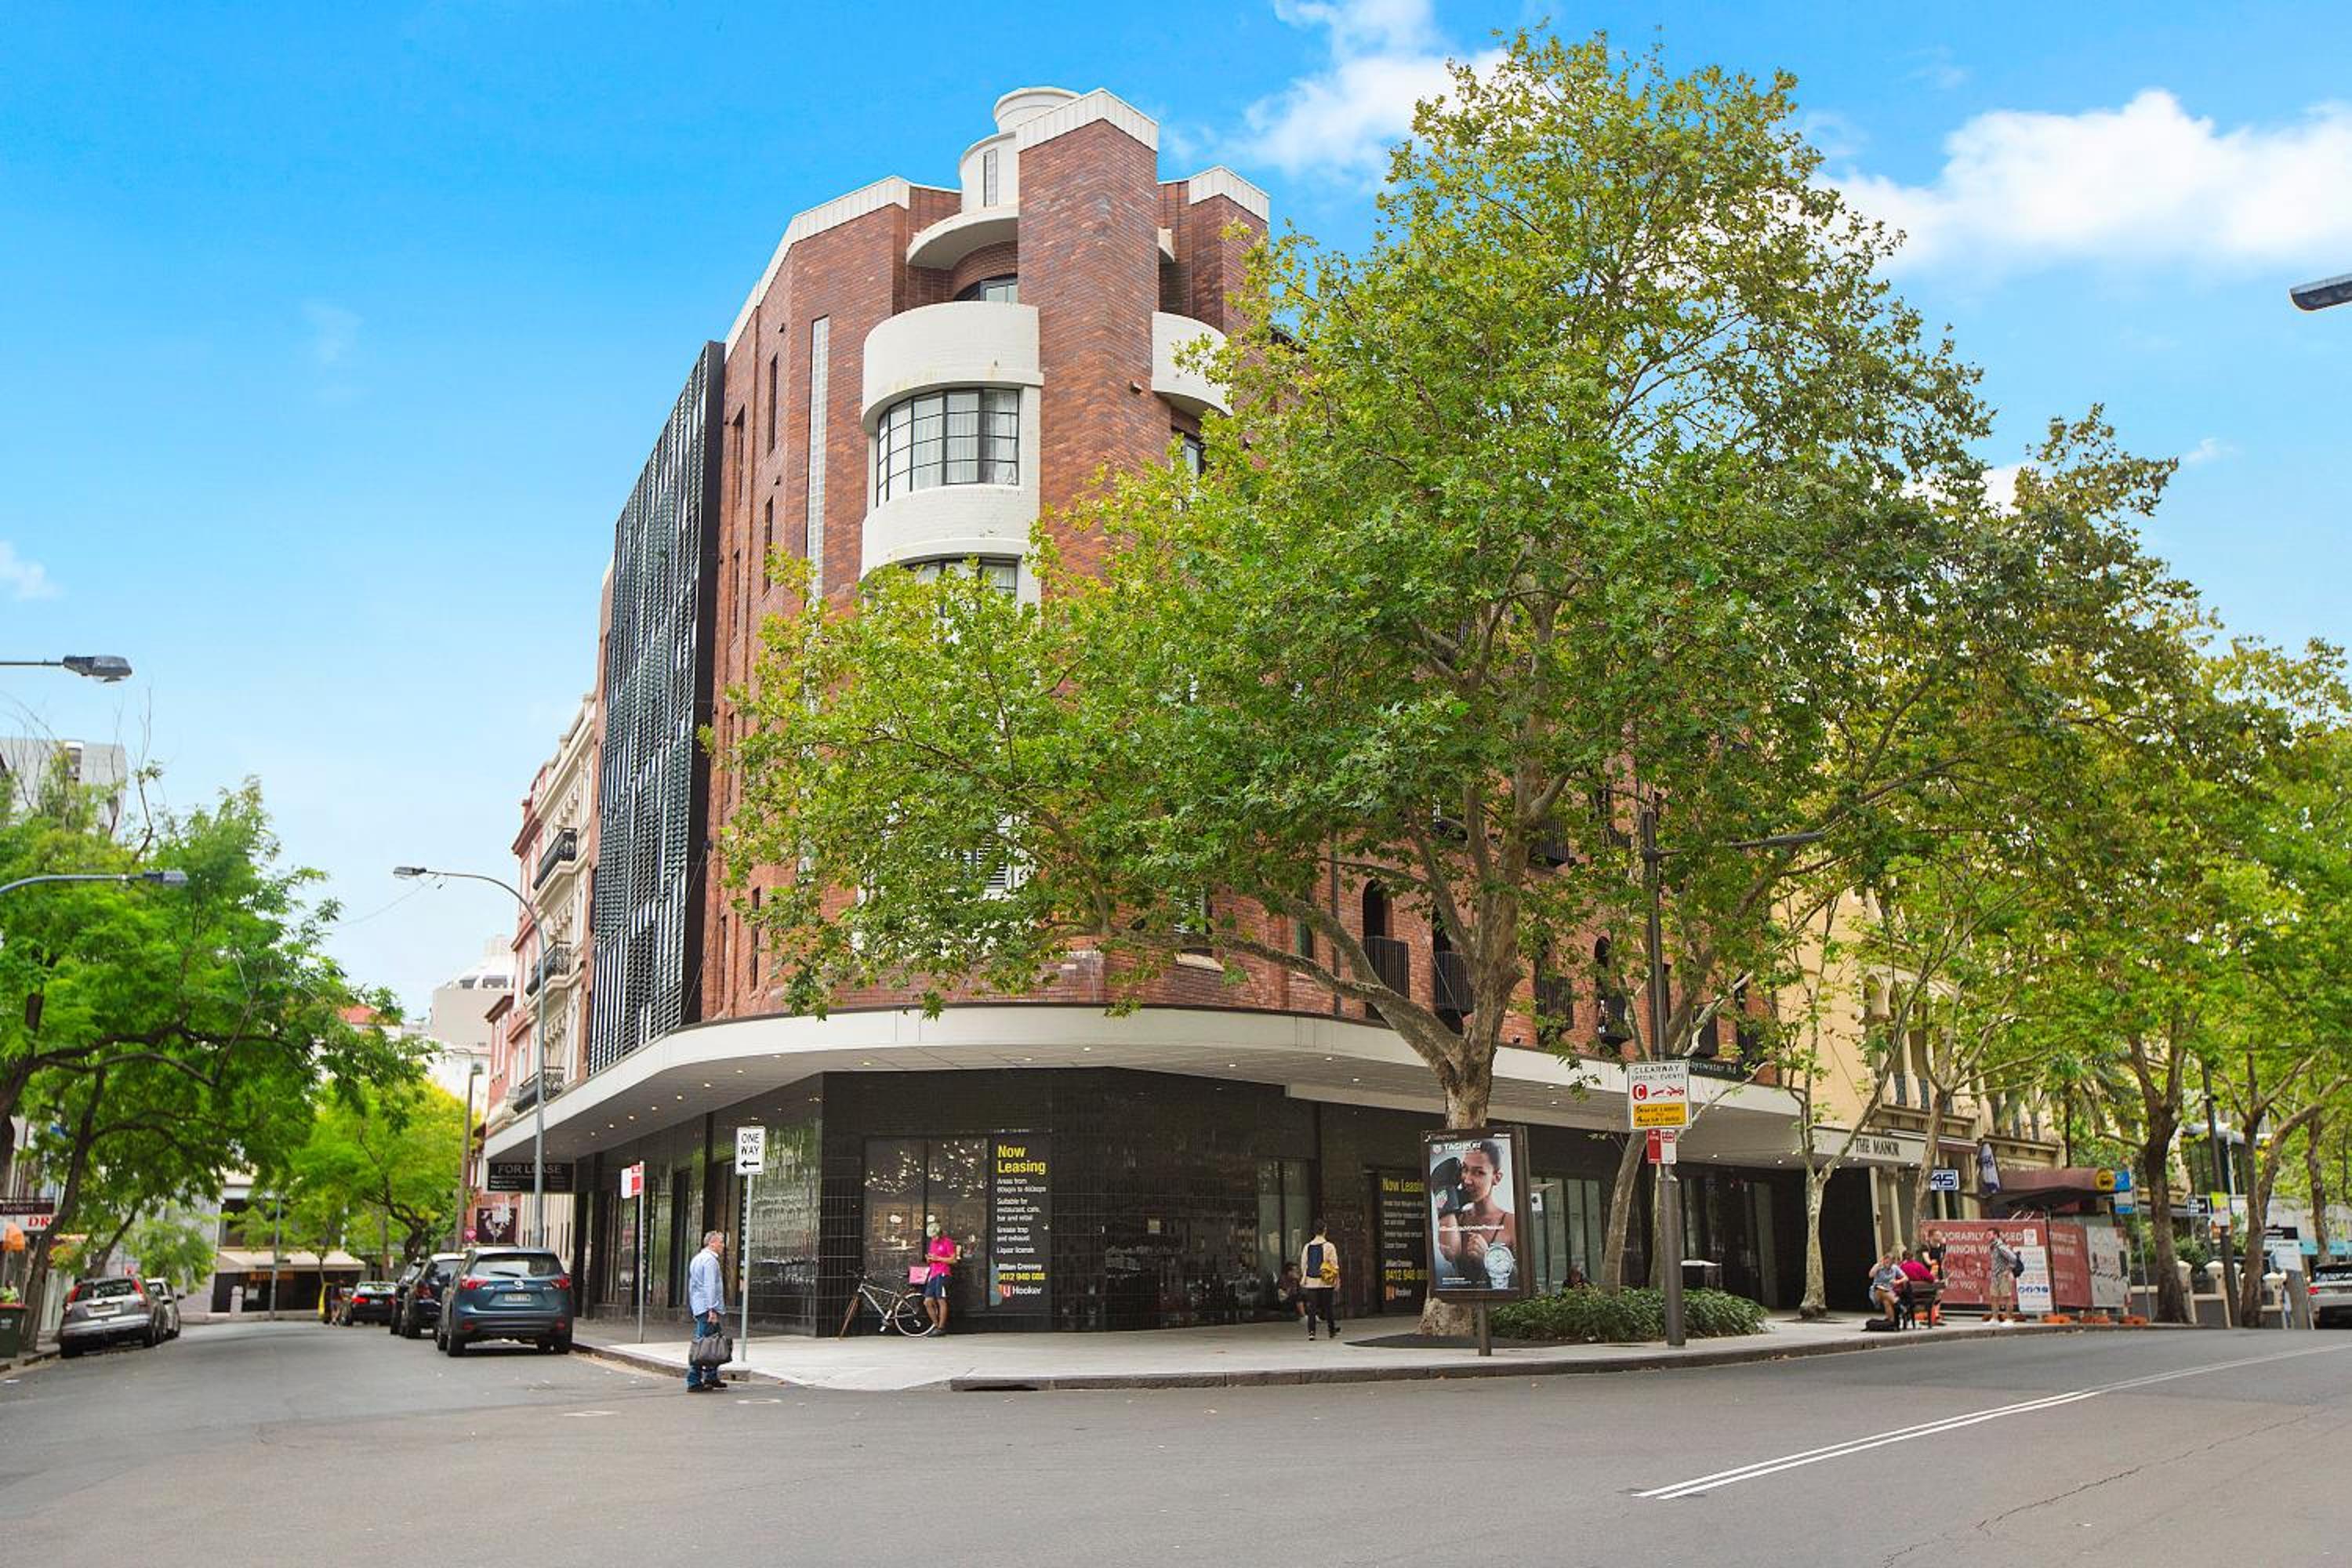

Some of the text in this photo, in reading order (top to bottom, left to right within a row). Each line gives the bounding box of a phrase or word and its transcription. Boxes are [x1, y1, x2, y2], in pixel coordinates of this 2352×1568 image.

[1634, 1065, 1679, 1074] CLEARWAY
[741, 1133, 760, 1144] ONE
[740, 1145, 760, 1156] WAY
[997, 1144, 1026, 1158] Now
[1856, 1138, 1900, 1156] THE MANOR
[498, 1164, 521, 1174] FOR
[997, 1160, 1046, 1175] Leasing
[1382, 1179, 1399, 1191] Now
[1012, 1285, 1042, 1295] Hooker
